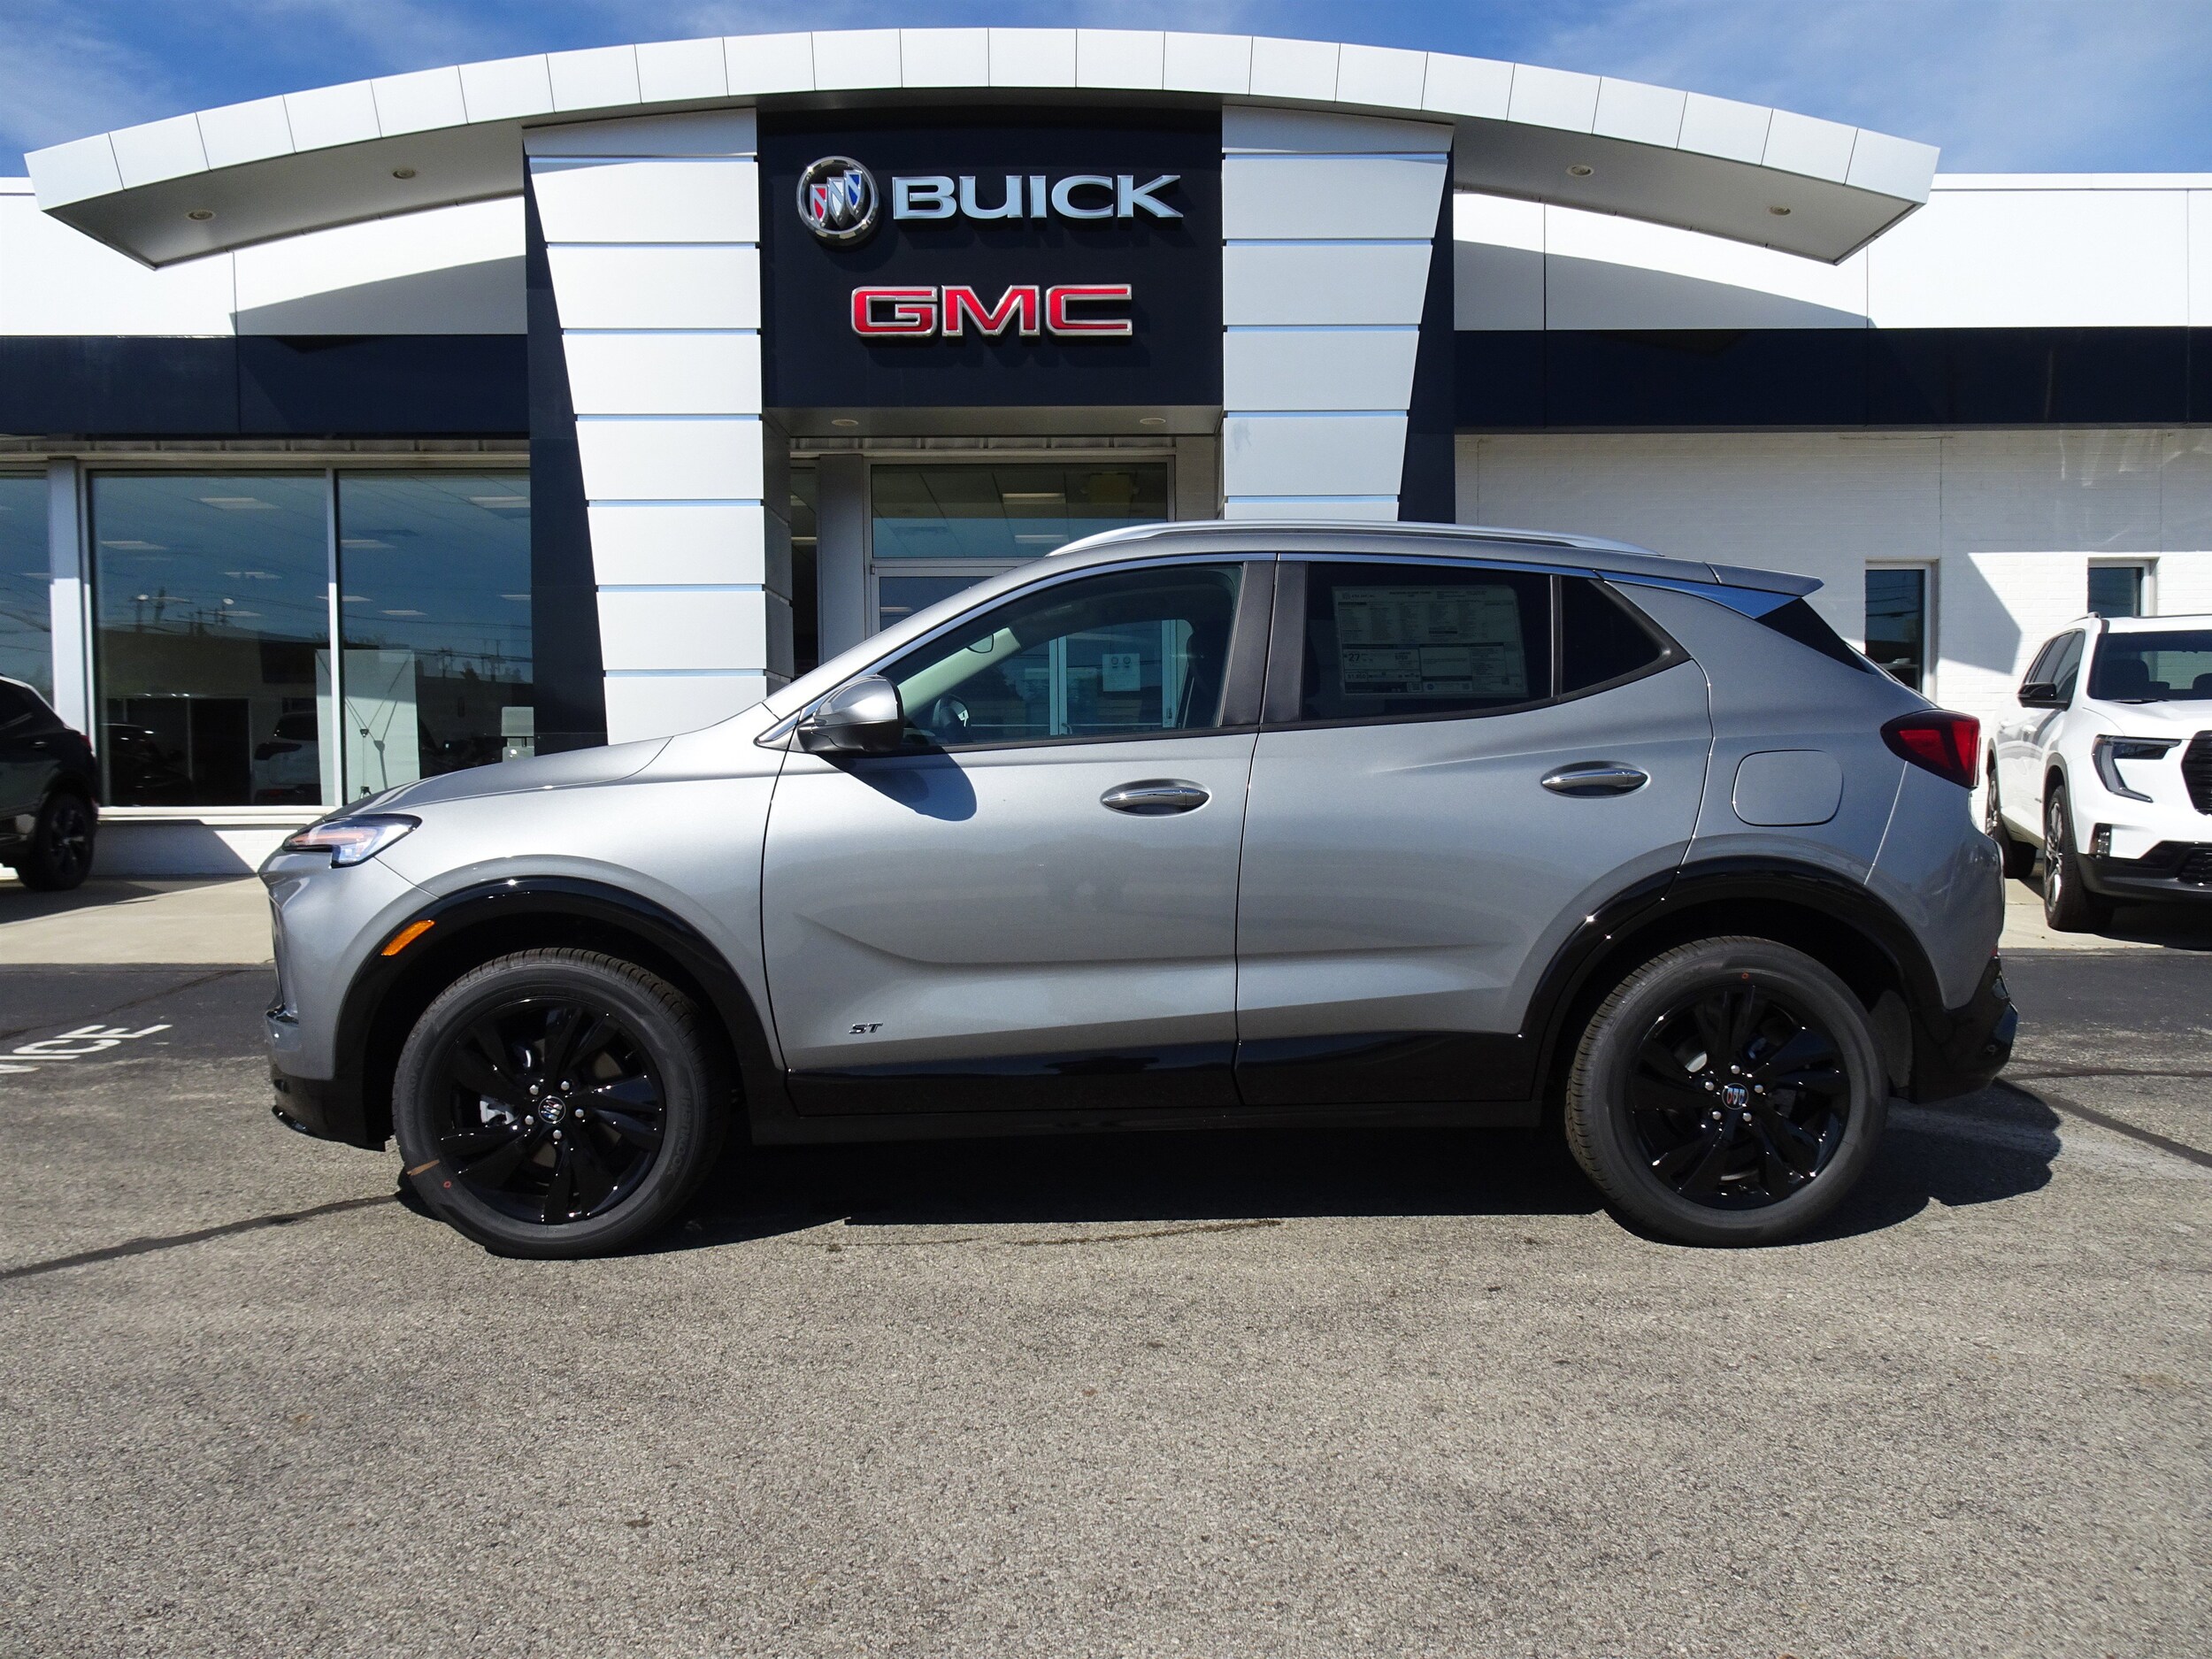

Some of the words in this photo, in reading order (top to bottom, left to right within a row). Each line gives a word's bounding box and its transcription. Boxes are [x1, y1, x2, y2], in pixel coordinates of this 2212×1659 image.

[891, 174, 1184, 220] BUICK
[850, 283, 1133, 338] GMC
[849, 1022, 884, 1035] ST
